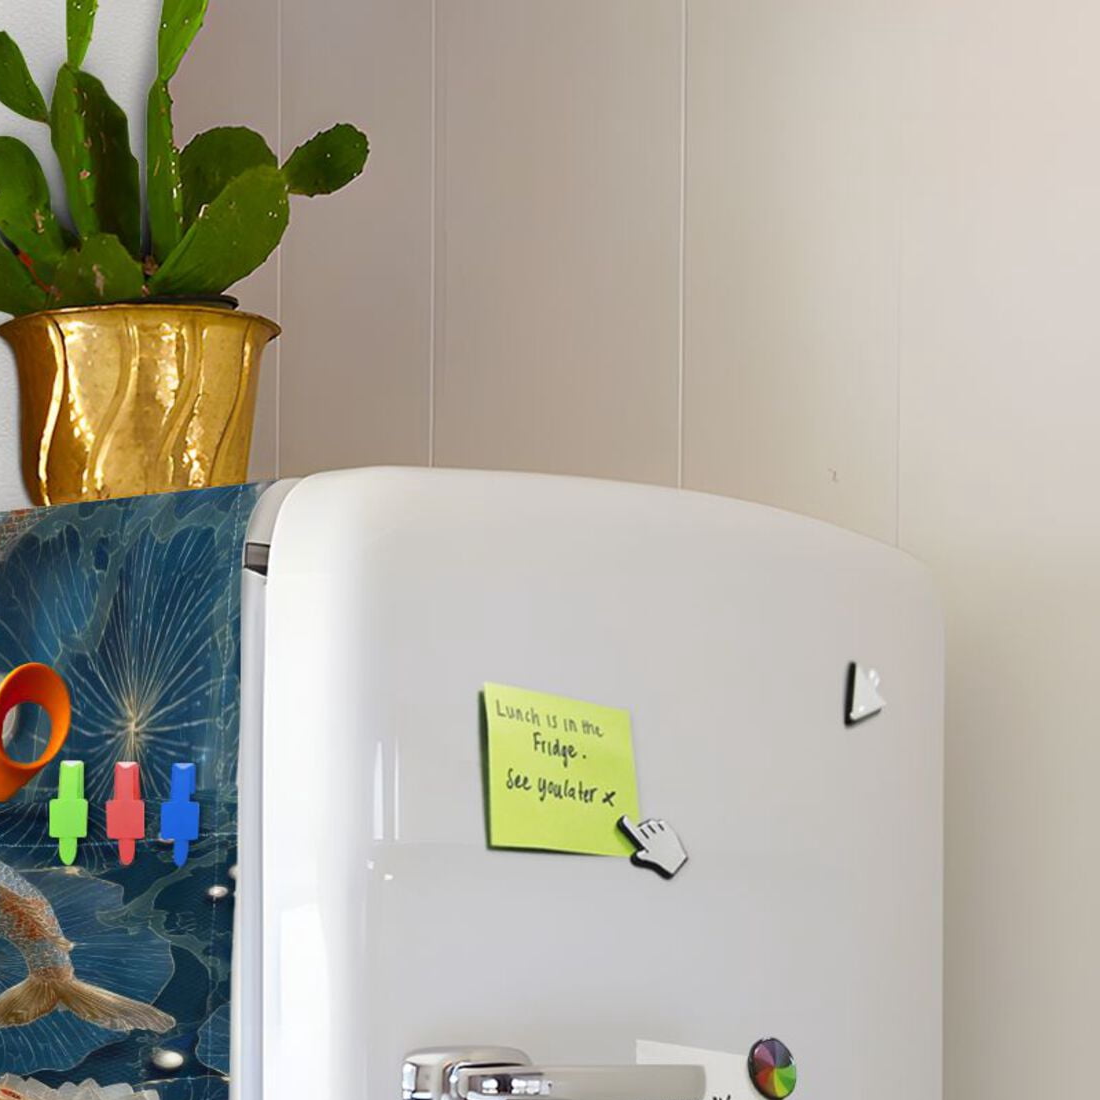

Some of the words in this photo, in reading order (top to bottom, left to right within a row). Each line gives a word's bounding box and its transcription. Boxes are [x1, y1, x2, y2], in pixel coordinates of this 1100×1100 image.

[496, 699, 540, 727] Lunch
[563, 718, 578, 733] in
[581, 719, 604, 738] the
[506, 767, 532, 790] See
